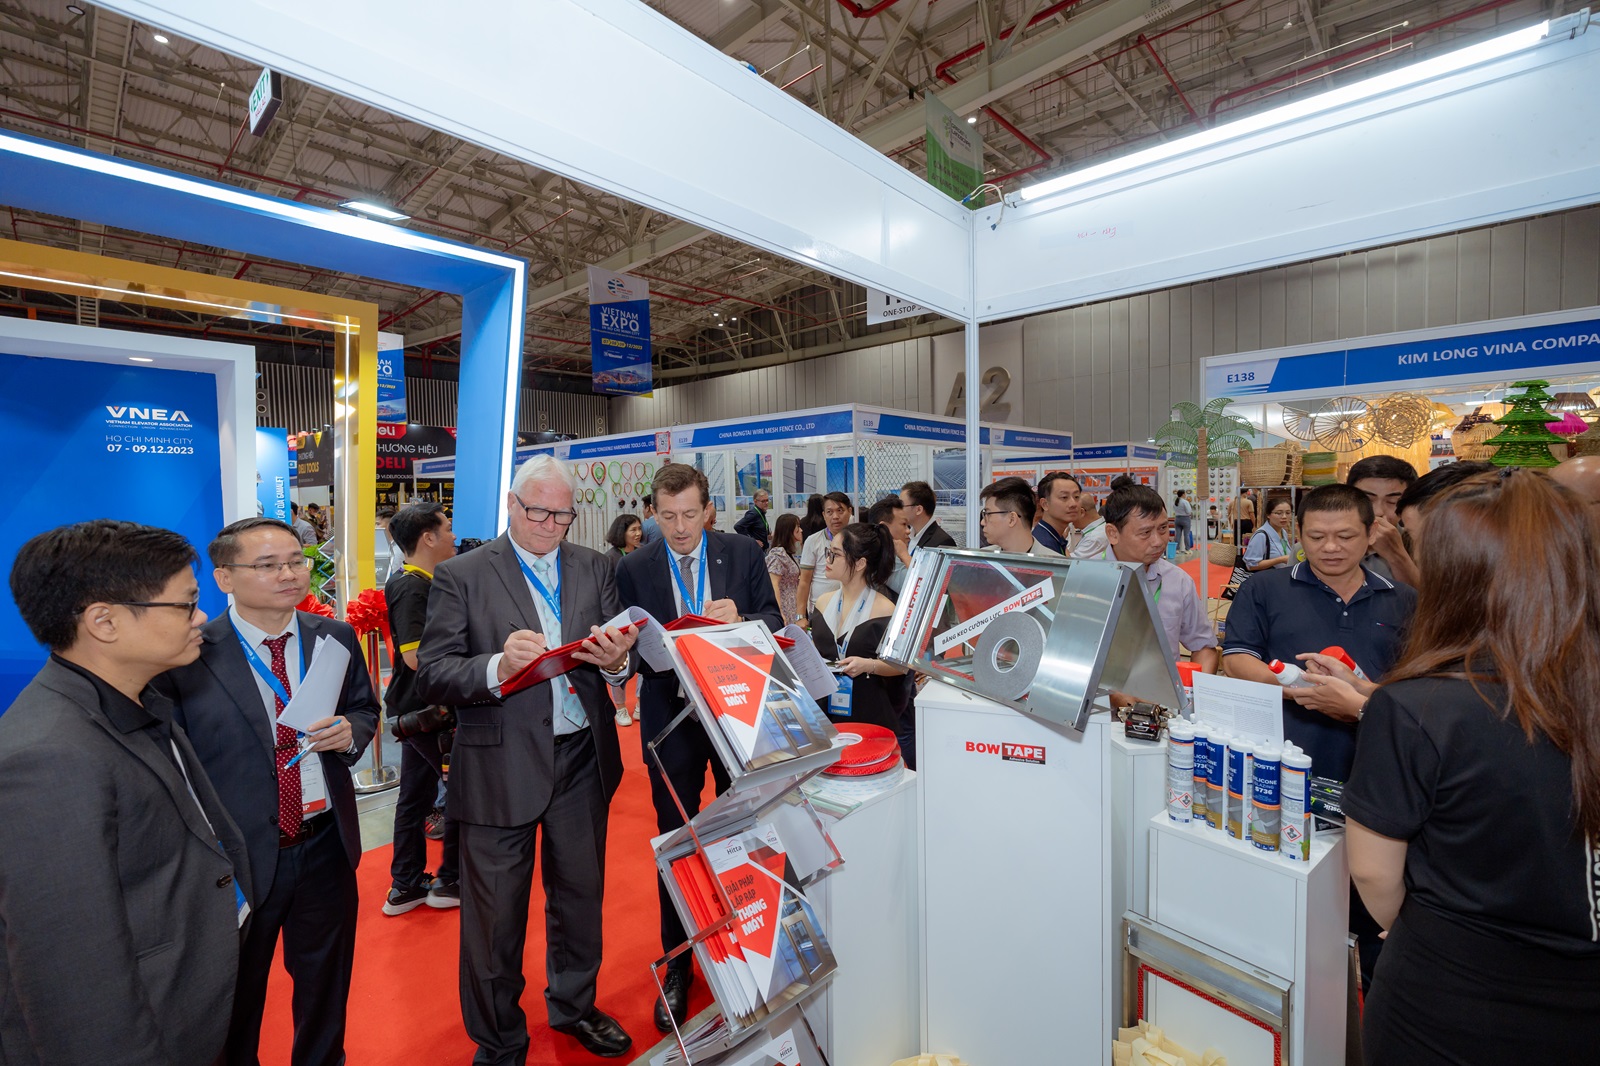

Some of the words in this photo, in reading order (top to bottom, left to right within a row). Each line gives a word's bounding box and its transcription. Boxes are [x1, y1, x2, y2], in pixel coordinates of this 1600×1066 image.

[601, 306, 639, 320] VIETNAM
[882, 304, 916, 317] ONE-STOP
[601, 313, 640, 331] EXPO
[1398, 352, 1428, 365] KIM
[1433, 347, 1478, 362] LONG
[1482, 341, 1527, 356] VINA
[1227, 372, 1255, 383] E138
[105, 405, 190, 422] VNEA
[124, 435, 142, 443] CHI
[144, 436, 171, 444] MINH
[173, 437, 194, 445] CITY
[106, 444, 122, 452] 07
[132, 445, 194, 454] 09.12.2023
[418, 444, 438, 455] HIỆU
[376, 457, 406, 469] DELI
[941, 634, 957, 646] BĂNG
[956, 628, 968, 638] KEO
[968, 616, 989, 632] CƯỜNG
[1003, 600, 1021, 613] BOW
[1021, 589, 1042, 605] TAPE
[717, 682, 751, 695] THANG
[723, 693, 748, 707] MÁY
[965, 741, 1000, 755] BOW
[1004, 744, 1043, 759] TAPE
[1254, 786, 1273, 795] S736
[726, 845, 743, 855] Hitta
[725, 880, 740, 896] GIẢI
[739, 874, 754, 889] PHÁP
[743, 888, 757, 901] RÁP
[737, 898, 768, 921] THANG
[741, 914, 765, 936] MÁY
[779, 1046, 793, 1058] Hitta
